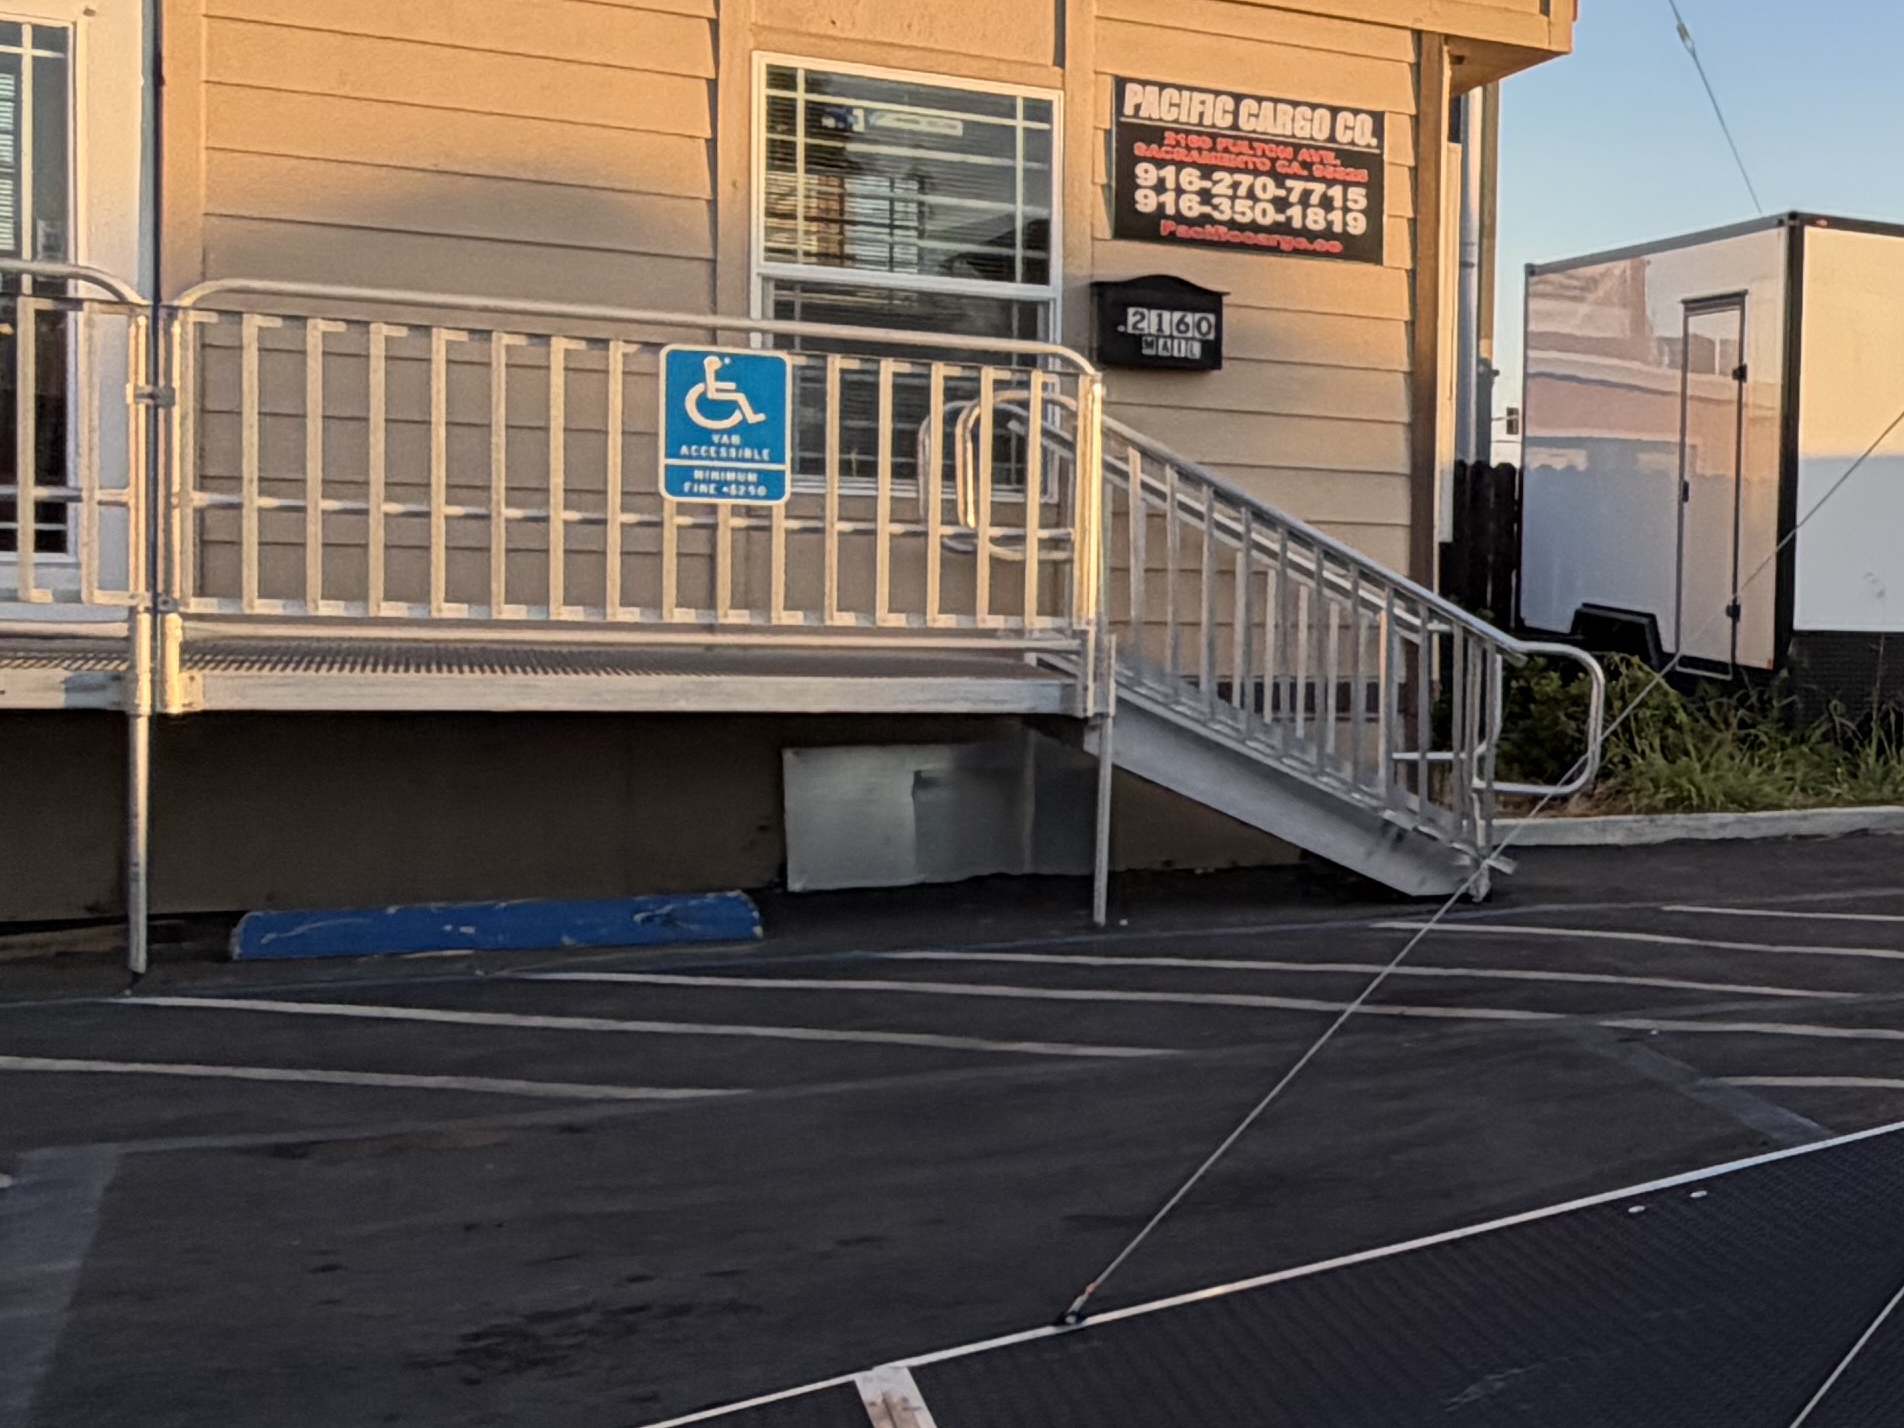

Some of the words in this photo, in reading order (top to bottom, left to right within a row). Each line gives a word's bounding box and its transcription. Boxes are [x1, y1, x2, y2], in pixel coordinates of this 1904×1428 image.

[1123, 82, 1235, 128] PACIFIC
[1238, 98, 1332, 142] CARGO
[1334, 111, 1378, 147] CO.
[1133, 141, 1271, 172] SACRAMENTO
[1134, 161, 1368, 210] 916-270-7715
[1134, 187, 1368, 236] 916-350-1819
[1130, 308, 1214, 339] 2160
[1142, 338, 1201, 359] MAIL
[680, 443, 771, 462] ACCESSIBLE
[711, 433, 742, 446] VAN
[683, 480, 718, 494] FINE
[693, 468, 758, 483] MINIMUM
